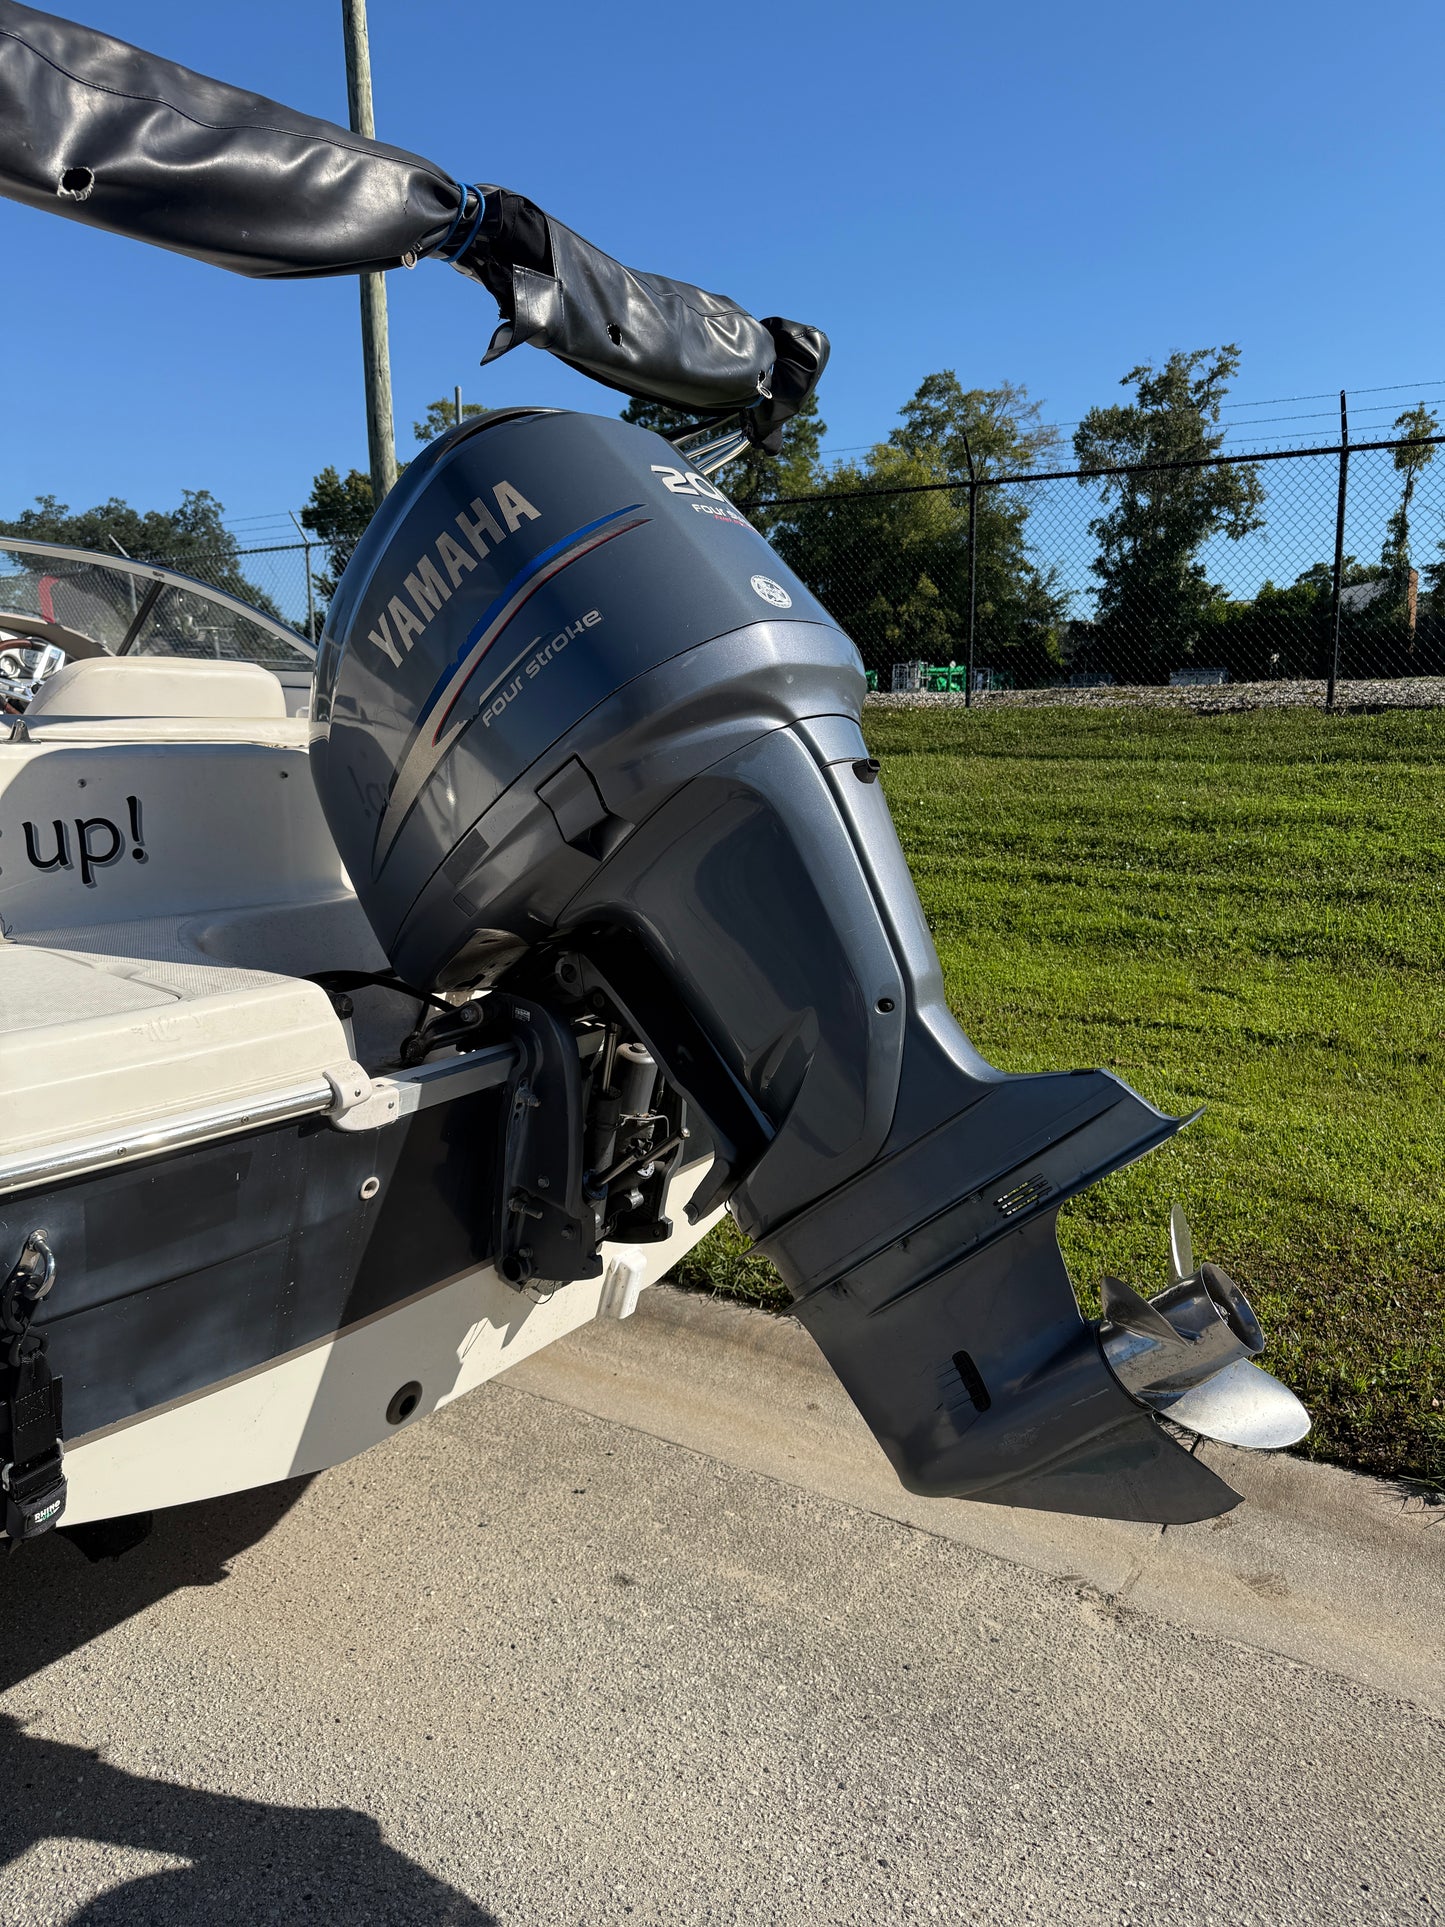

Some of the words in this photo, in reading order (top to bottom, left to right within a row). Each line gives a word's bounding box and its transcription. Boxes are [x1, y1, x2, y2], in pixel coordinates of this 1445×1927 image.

[650, 464, 731, 503] 20
[368, 480, 542, 669] YAMAHA
[22, 795, 148, 888] up!
[34, 1499, 61, 1521] RHINO
